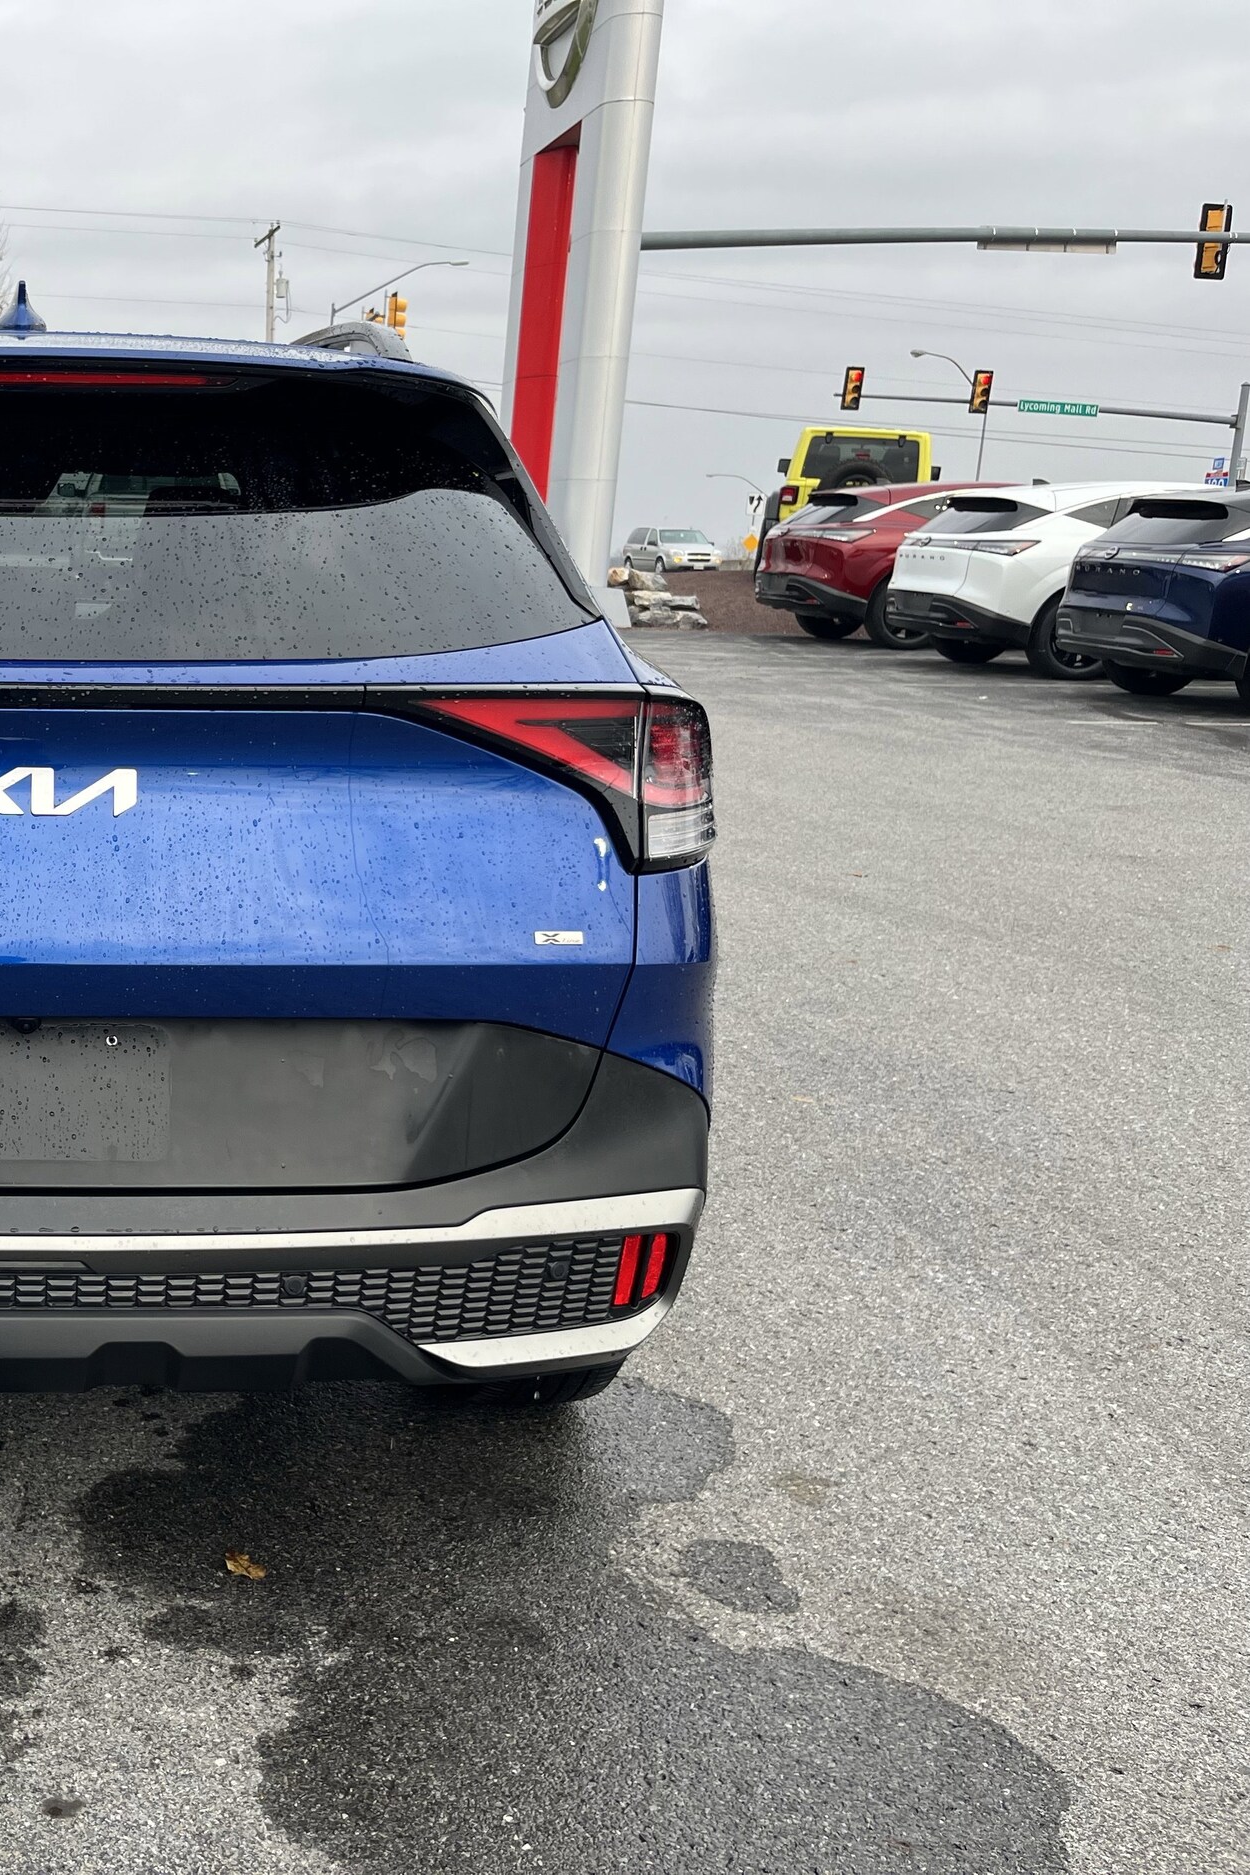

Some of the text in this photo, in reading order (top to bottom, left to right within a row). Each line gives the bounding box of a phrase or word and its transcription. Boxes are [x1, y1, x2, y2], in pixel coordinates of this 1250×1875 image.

[1020, 401, 1097, 415] Lycoming Mall Rd
